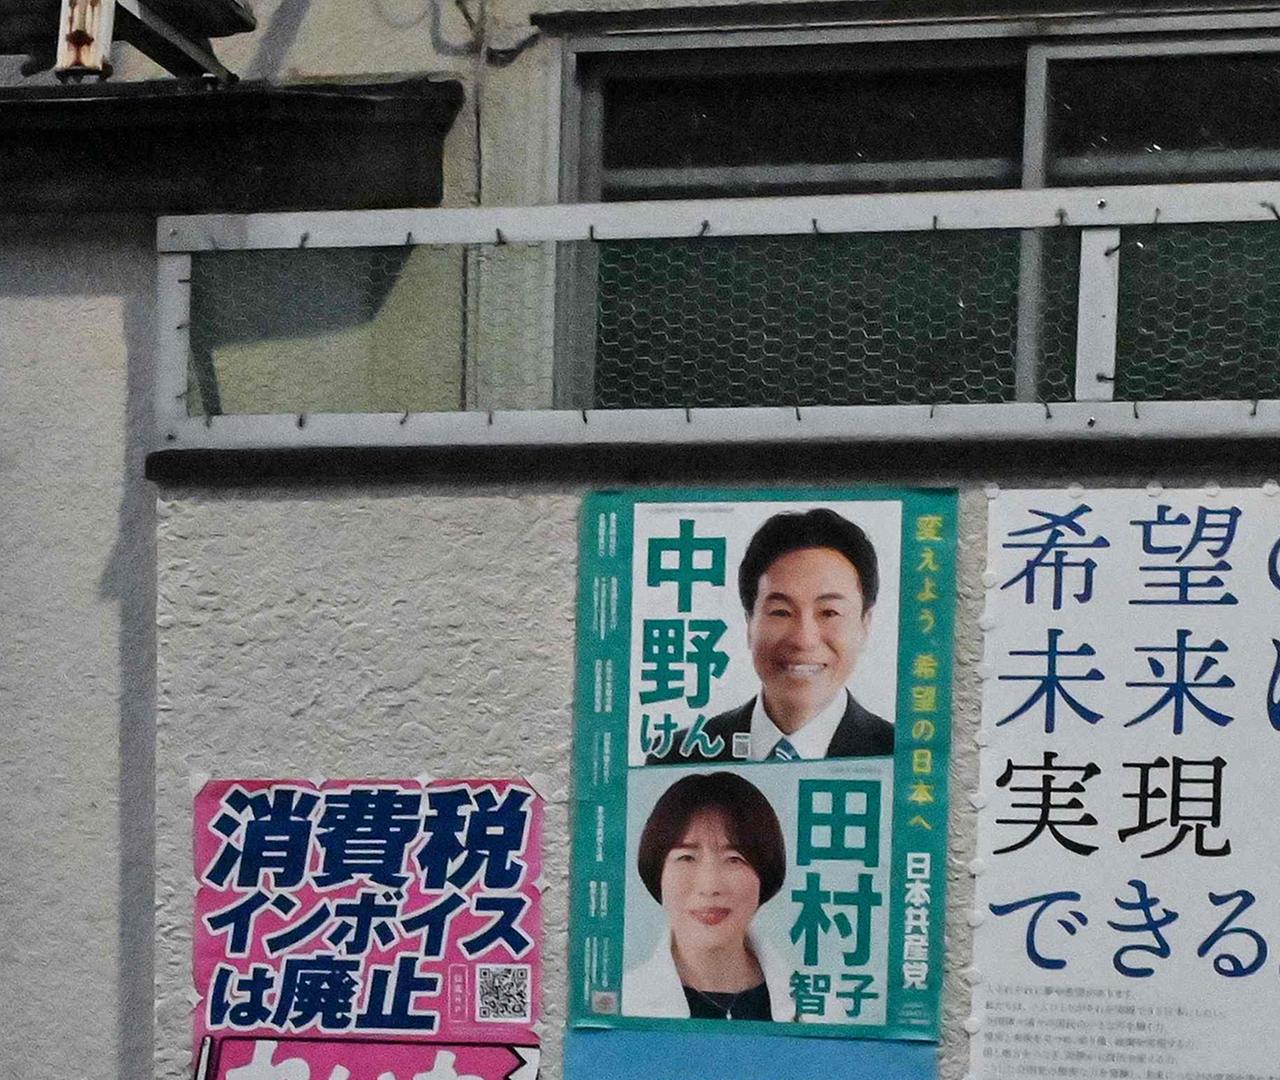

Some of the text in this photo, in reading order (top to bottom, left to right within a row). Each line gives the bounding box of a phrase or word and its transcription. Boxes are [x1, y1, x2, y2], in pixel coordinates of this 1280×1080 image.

[639, 519, 730, 709] 中野
[641, 713, 725, 758] けん
[204, 785, 533, 891] 消費税
[993, 752, 1231, 860] 実現
[206, 892, 535, 957] インボイス
[790, 778, 882, 966] 田村
[903, 852, 932, 990] 日本共産党
[209, 954, 441, 1032] は廃止
[789, 971, 879, 1018] 智子
